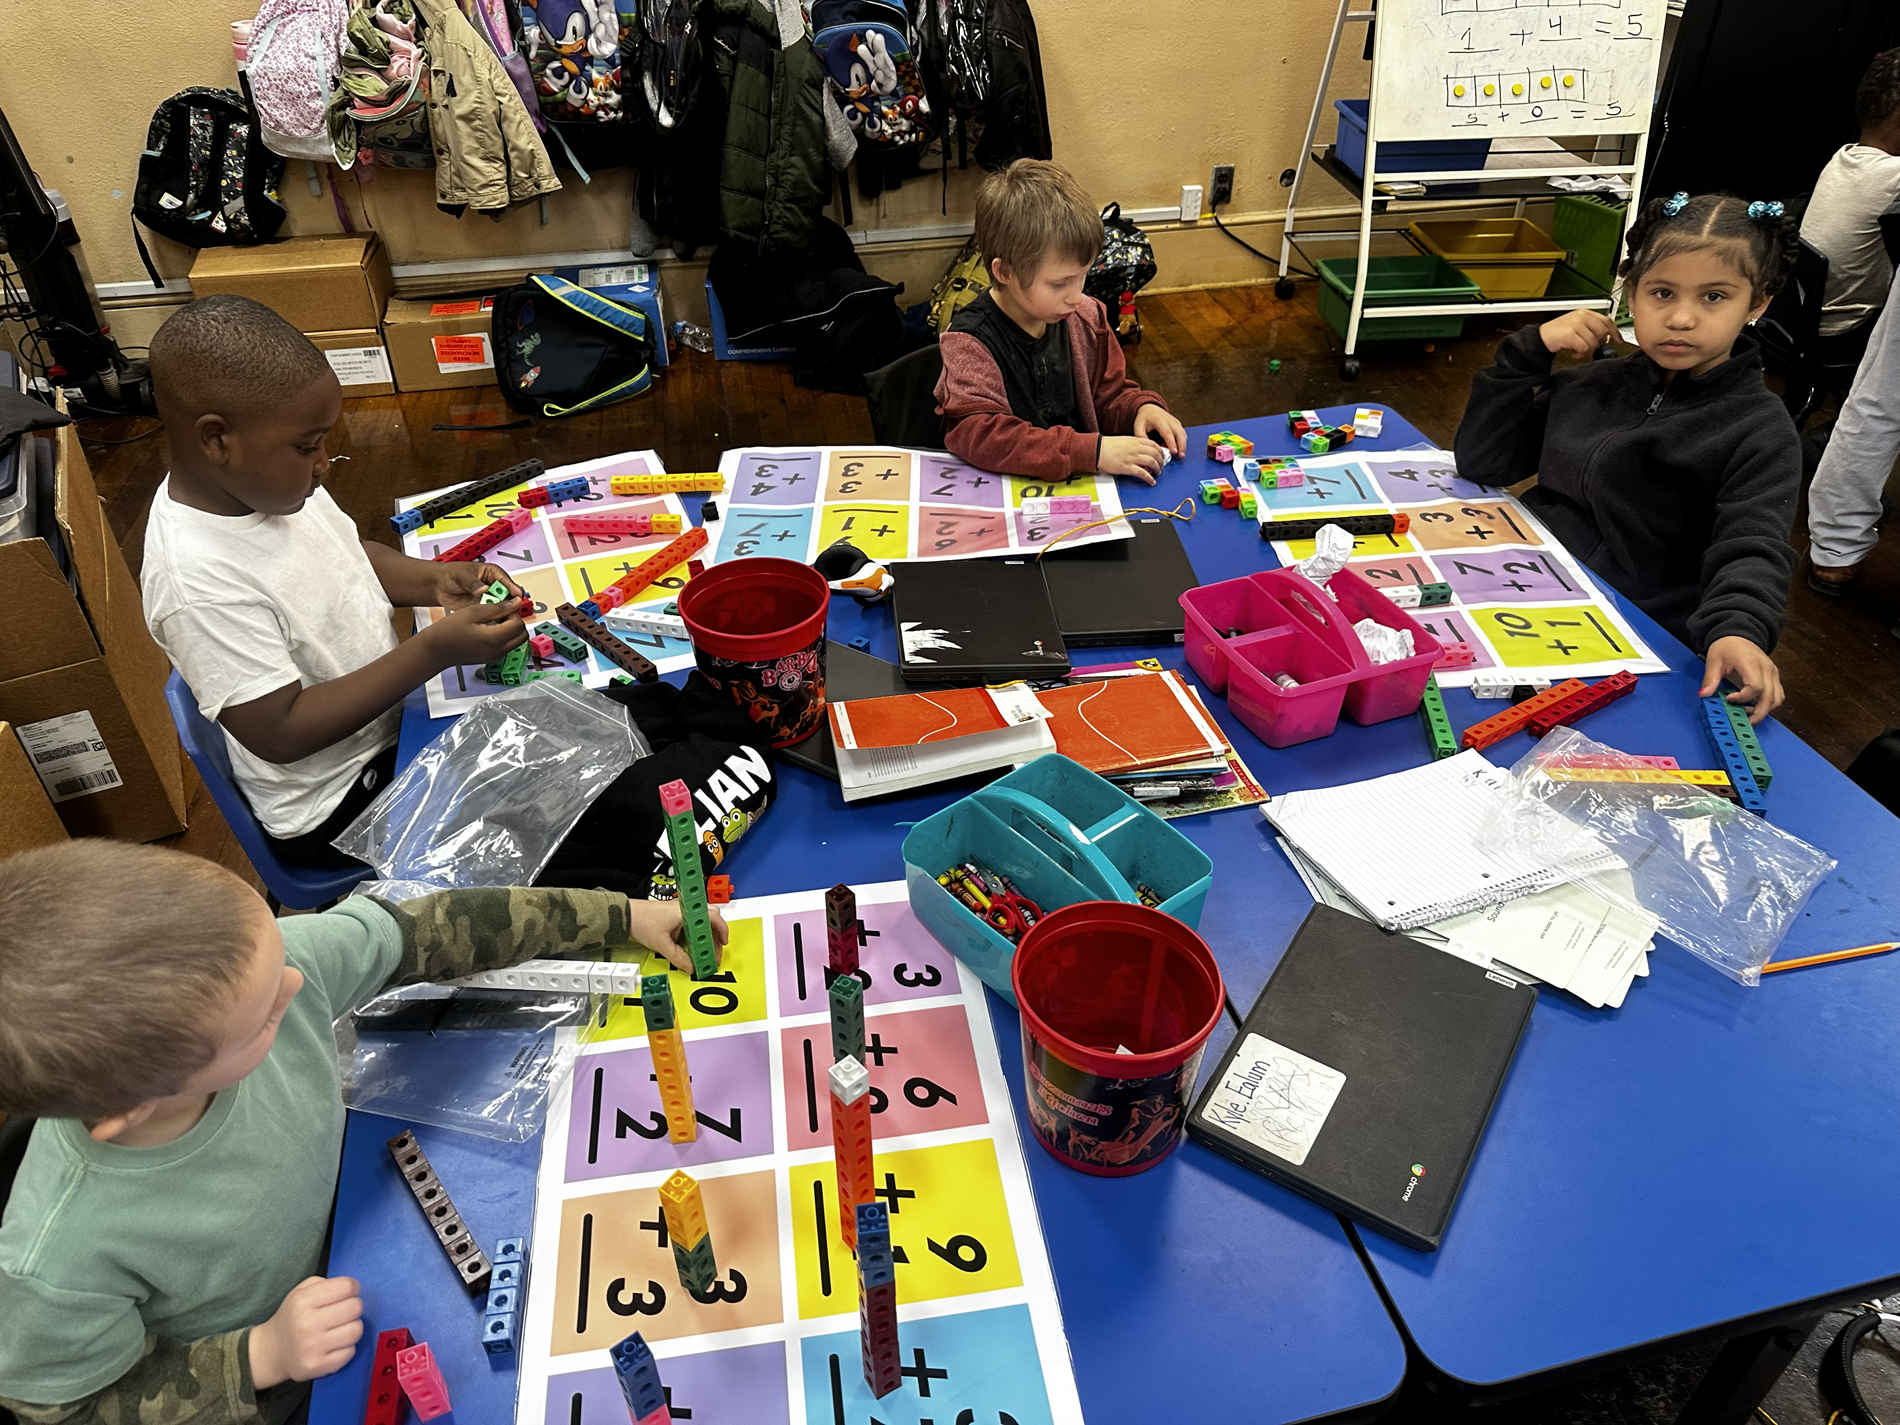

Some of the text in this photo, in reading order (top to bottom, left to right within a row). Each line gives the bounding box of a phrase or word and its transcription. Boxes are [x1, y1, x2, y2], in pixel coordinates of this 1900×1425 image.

[1461, 27, 1475, 50] 1
[1510, 29, 1533, 46] +
[1549, 15, 1562, 36] 4
[1627, 13, 1643, 37] 5
[1606, 100, 1622, 116] 5
[1388, 469, 1419, 482] 4
[1419, 512, 1454, 523] 3
[1494, 612, 1541, 638] 10
[1230, 760, 1256, 793] SCHOLASTIC
[893, 962, 942, 987] 3
[1488, 973, 1514, 986] Lenovo
[903, 1077, 958, 1109] 6
[1037, 1083, 1098, 1126] Kitchen
[615, 1108, 669, 1140] 2
[694, 1107, 743, 1143] 7
[1402, 1176, 1418, 1201] chrome
[926, 1234, 987, 1273] 9
[606, 1277, 666, 1316] 3
